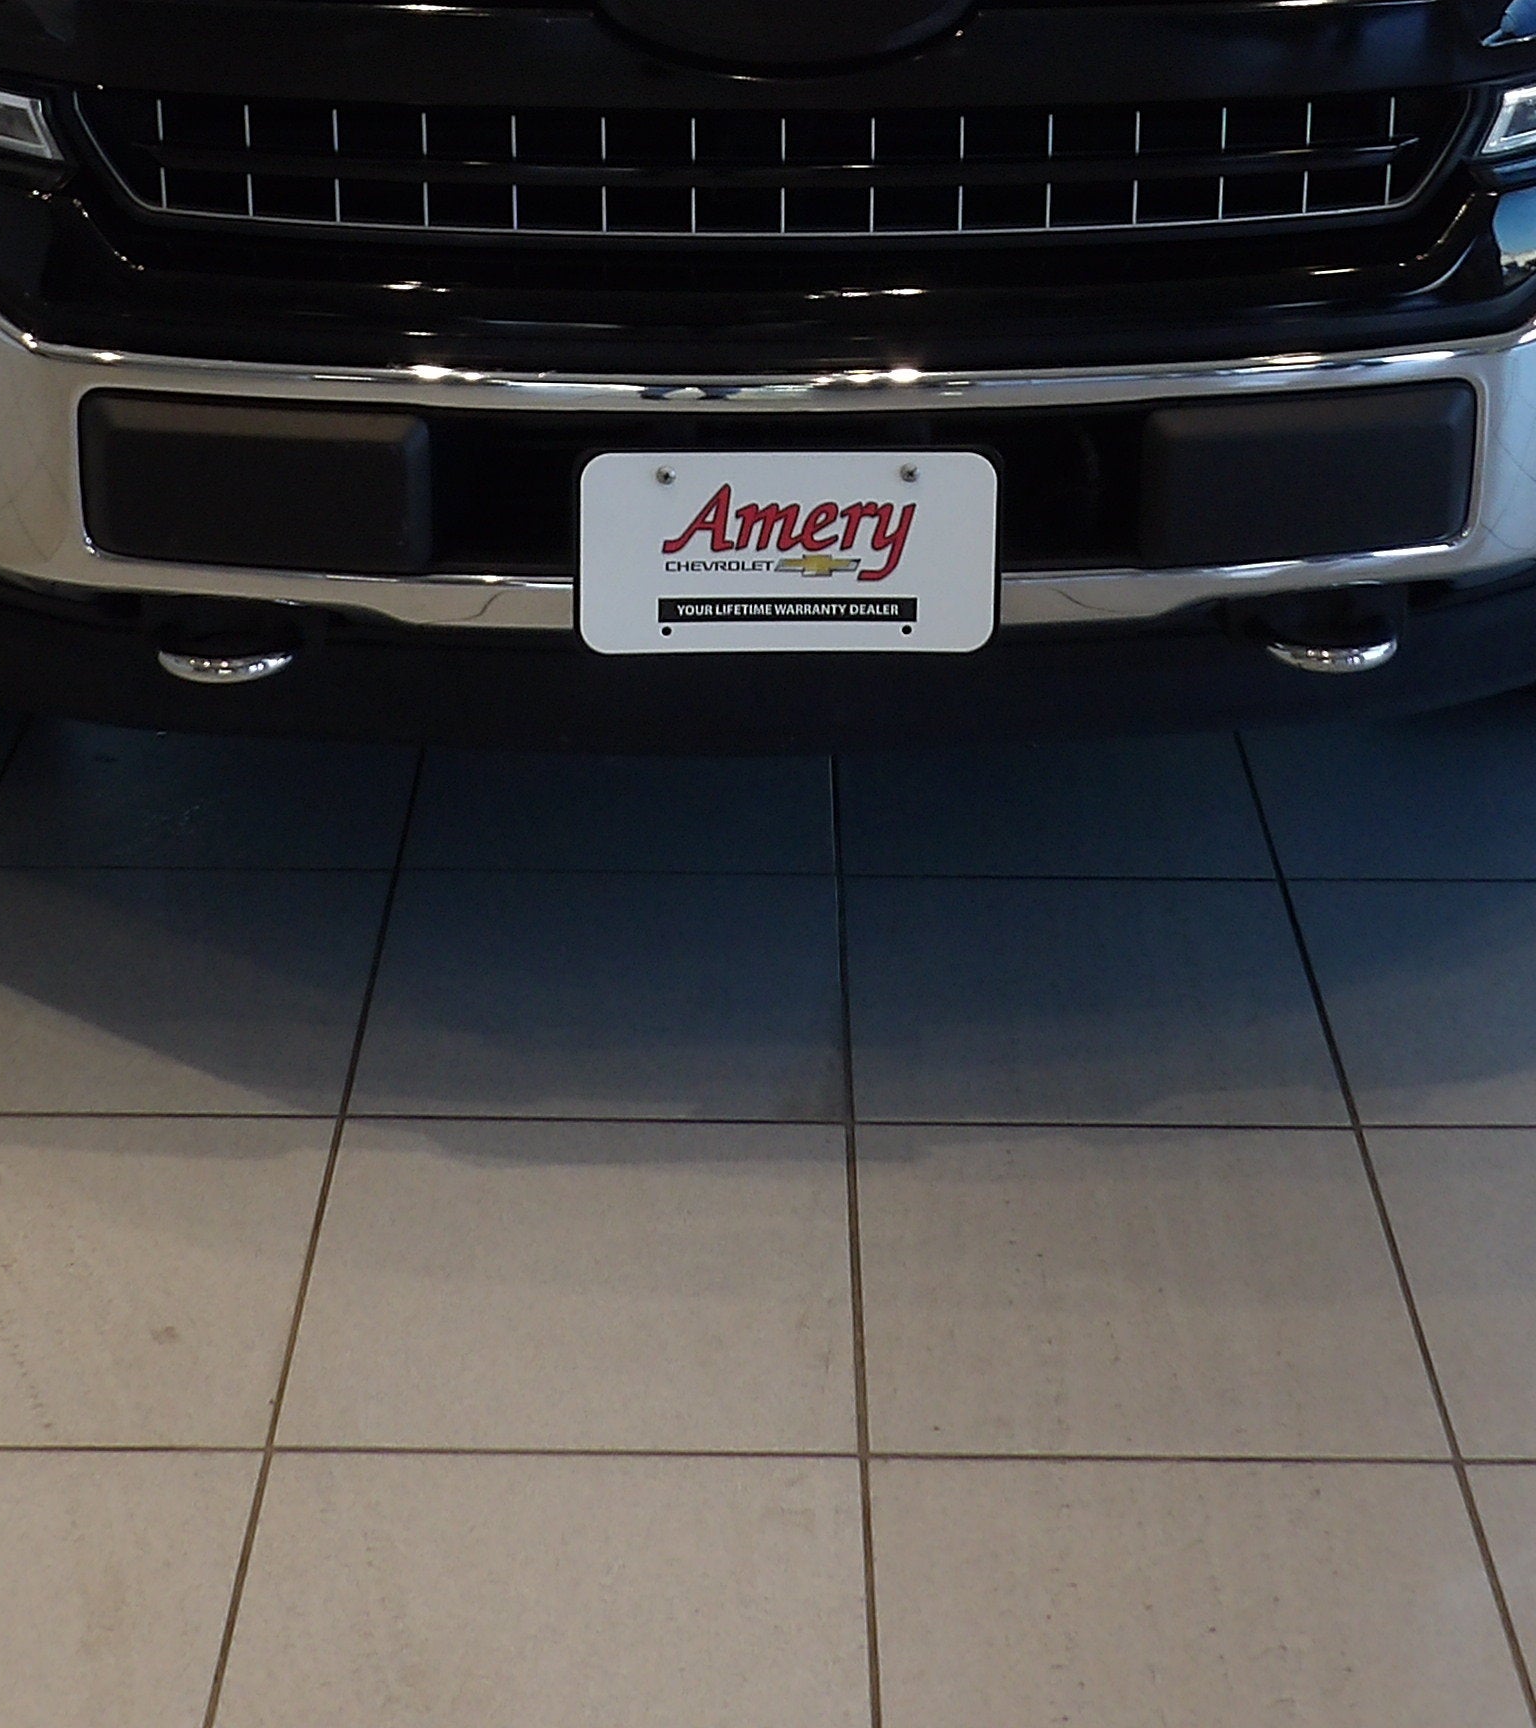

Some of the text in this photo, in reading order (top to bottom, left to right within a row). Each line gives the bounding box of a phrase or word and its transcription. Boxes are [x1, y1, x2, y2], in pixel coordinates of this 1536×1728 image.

[662, 483, 916, 581] Amery
[665, 560, 774, 572] CHEVROLET
[677, 603, 899, 616] YOUR LIFETIME WARRANTY DEALER
